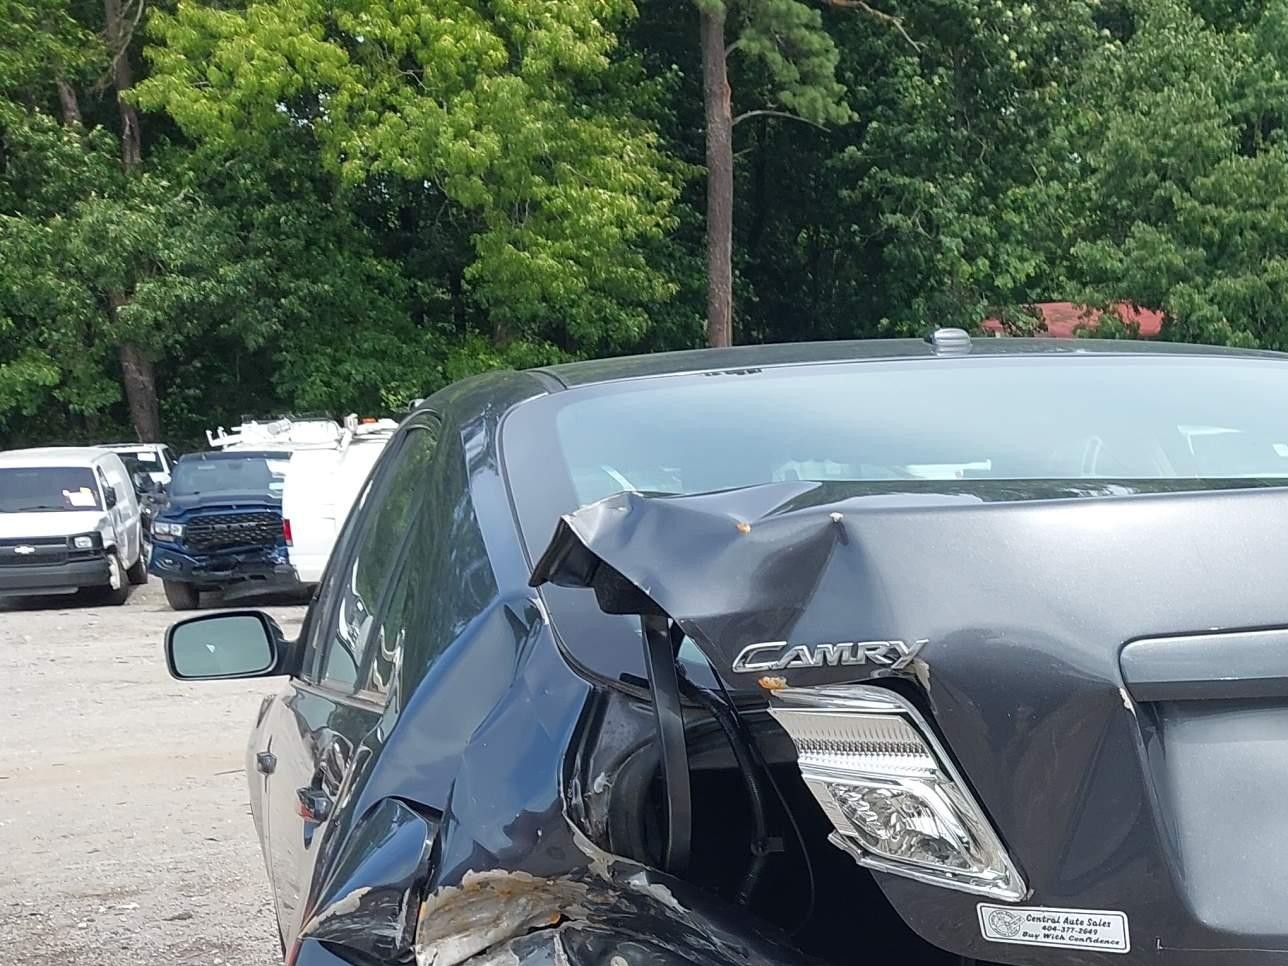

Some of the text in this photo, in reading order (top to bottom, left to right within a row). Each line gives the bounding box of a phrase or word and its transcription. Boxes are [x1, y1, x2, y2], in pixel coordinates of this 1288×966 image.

[732, 638, 929, 673] CAMRY
[1026, 914, 1111, 928] Central Auto Sales
[1021, 931, 1120, 945] Buy With Confidence
